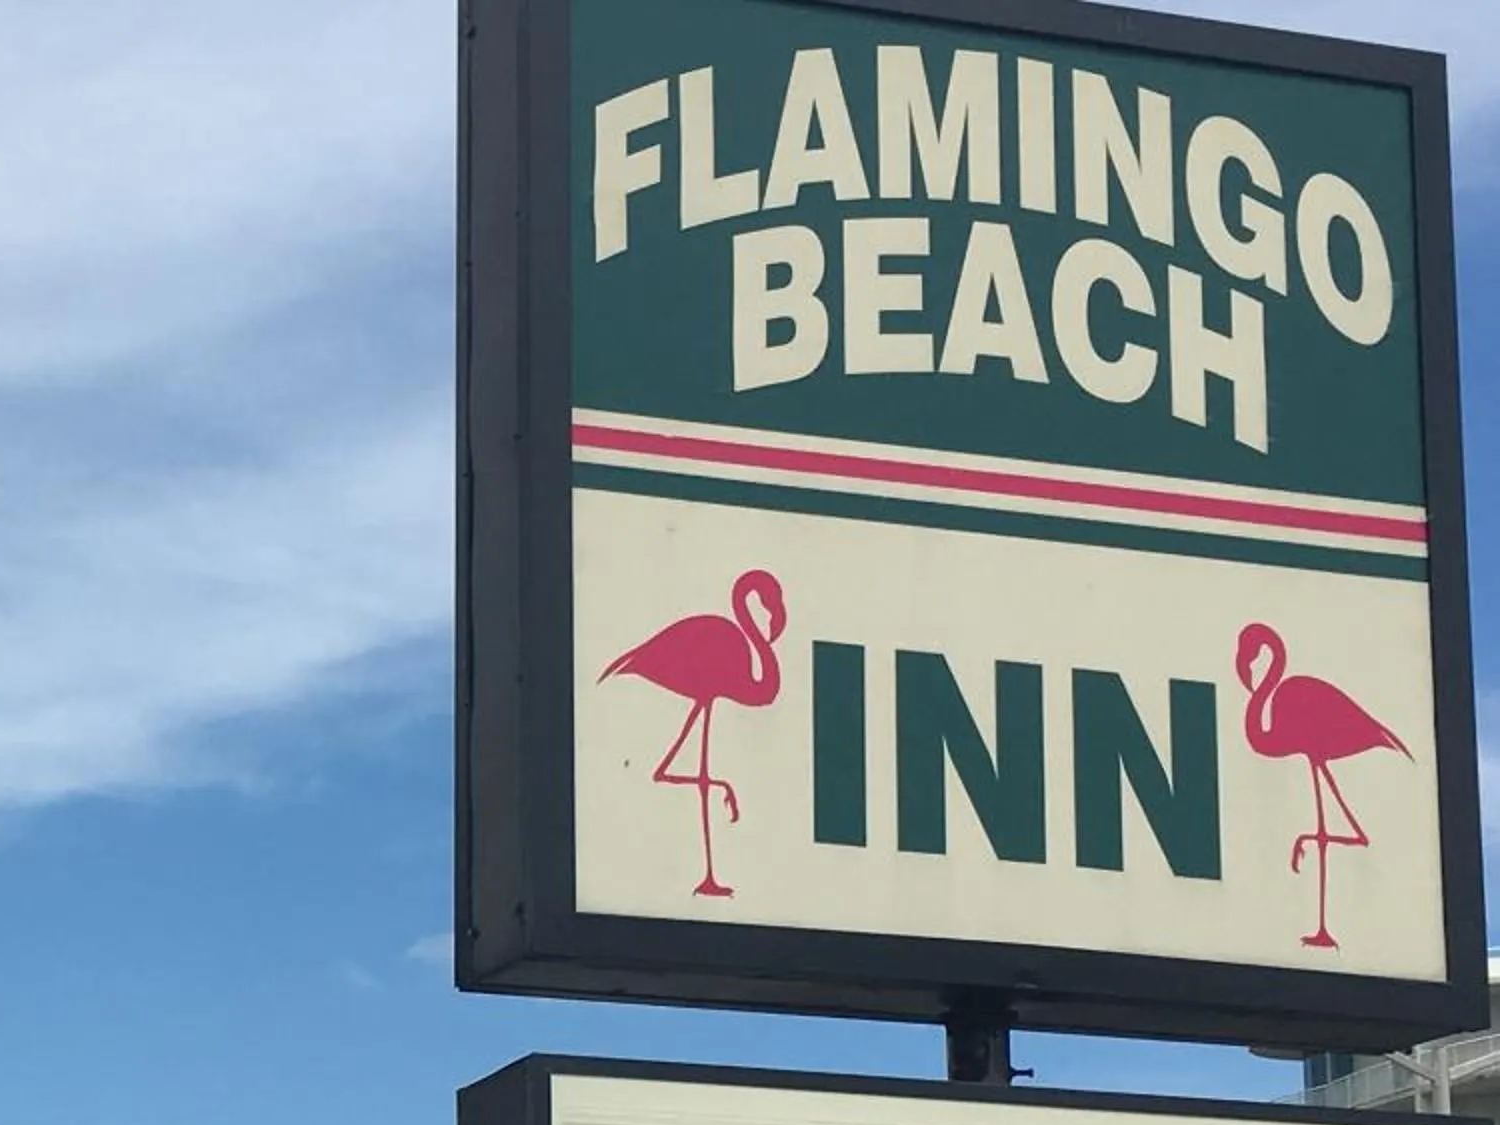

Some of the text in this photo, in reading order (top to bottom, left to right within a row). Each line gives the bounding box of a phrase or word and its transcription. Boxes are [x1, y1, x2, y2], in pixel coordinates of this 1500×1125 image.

[594, 45, 1394, 346] FLAMINGO
[733, 218, 1269, 455] BEACH
[812, 639, 1222, 881] INN
